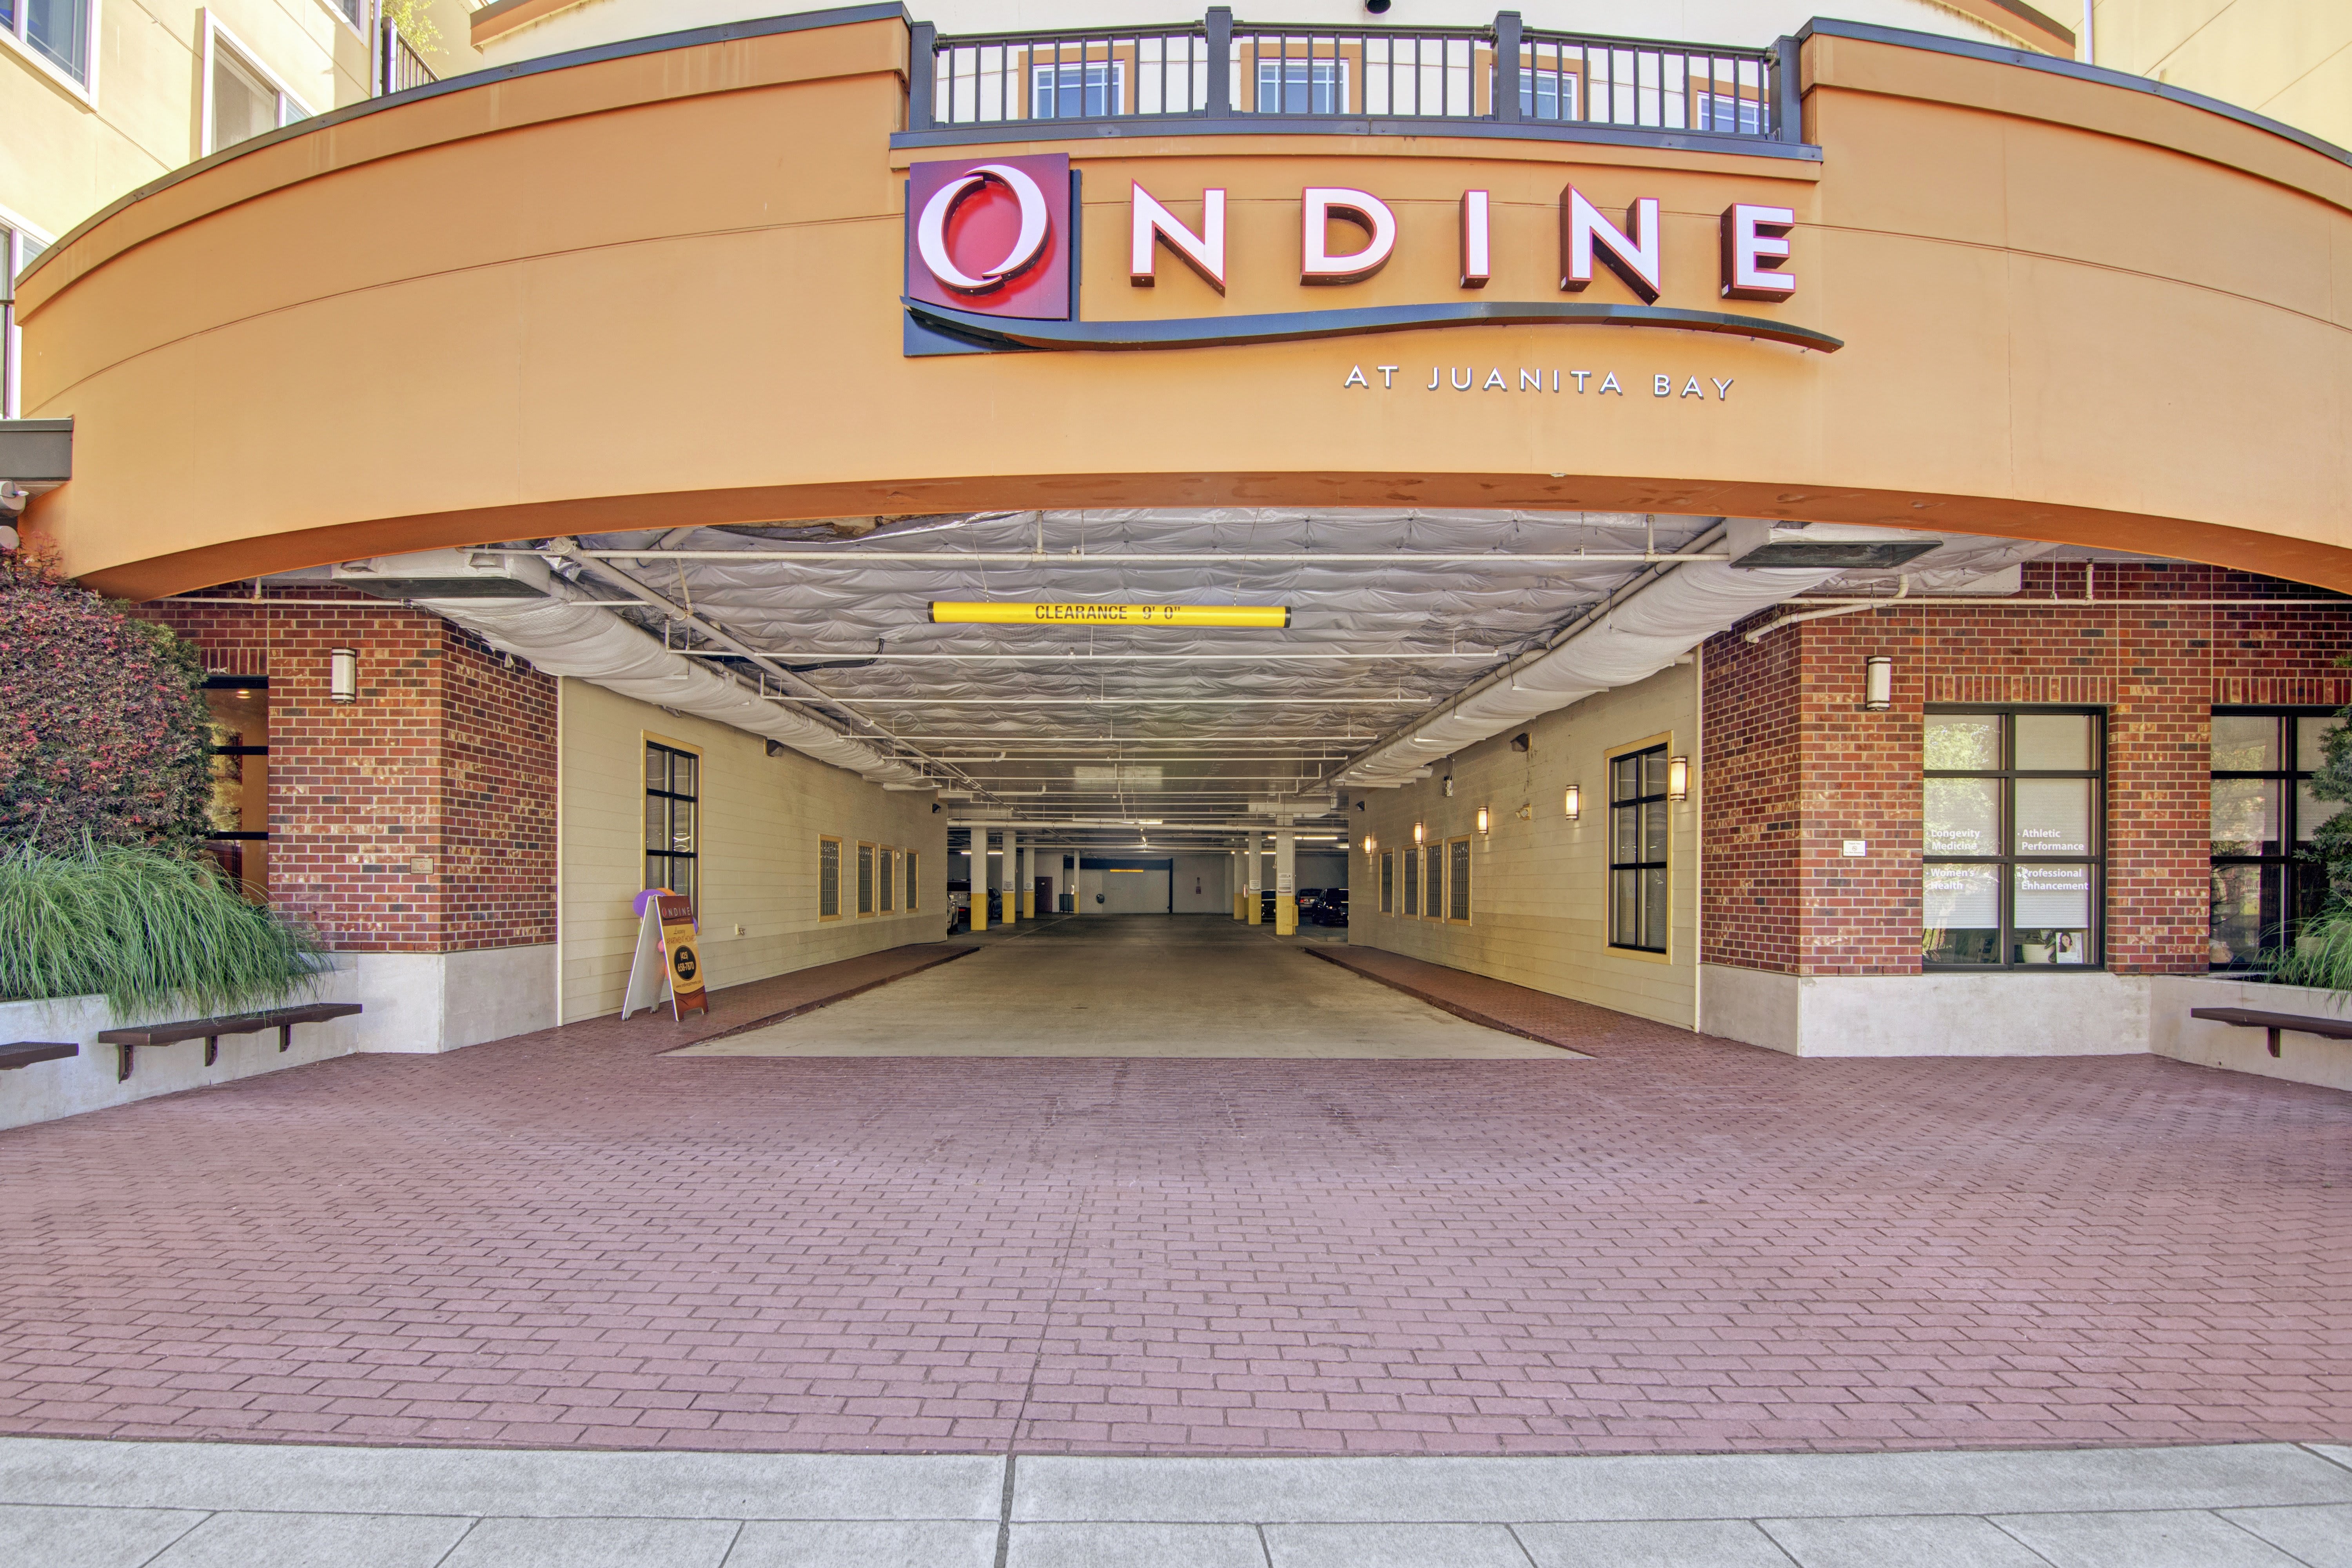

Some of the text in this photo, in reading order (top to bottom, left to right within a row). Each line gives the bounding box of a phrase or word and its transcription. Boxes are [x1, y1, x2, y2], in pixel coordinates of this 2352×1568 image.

[918, 164, 1796, 304] ONDINE
[1344, 364, 1734, 400] AT JUANITA BAY
[1035, 605, 1127, 620] CLEARANCE
[1931, 829, 1980, 839] Longevity
[2022, 829, 2061, 837] Athletic
[1932, 842, 1977, 850] Medicine
[2022, 842, 2084, 850] Performance
[1931, 868, 1975, 877] Women's
[2022, 868, 2082, 877] Professional
[1931, 881, 1963, 889] Health
[2022, 881, 2089, 890] Enhancement
[662, 907, 690, 917] ONDINE
[678, 961, 694, 972] 658-7870
